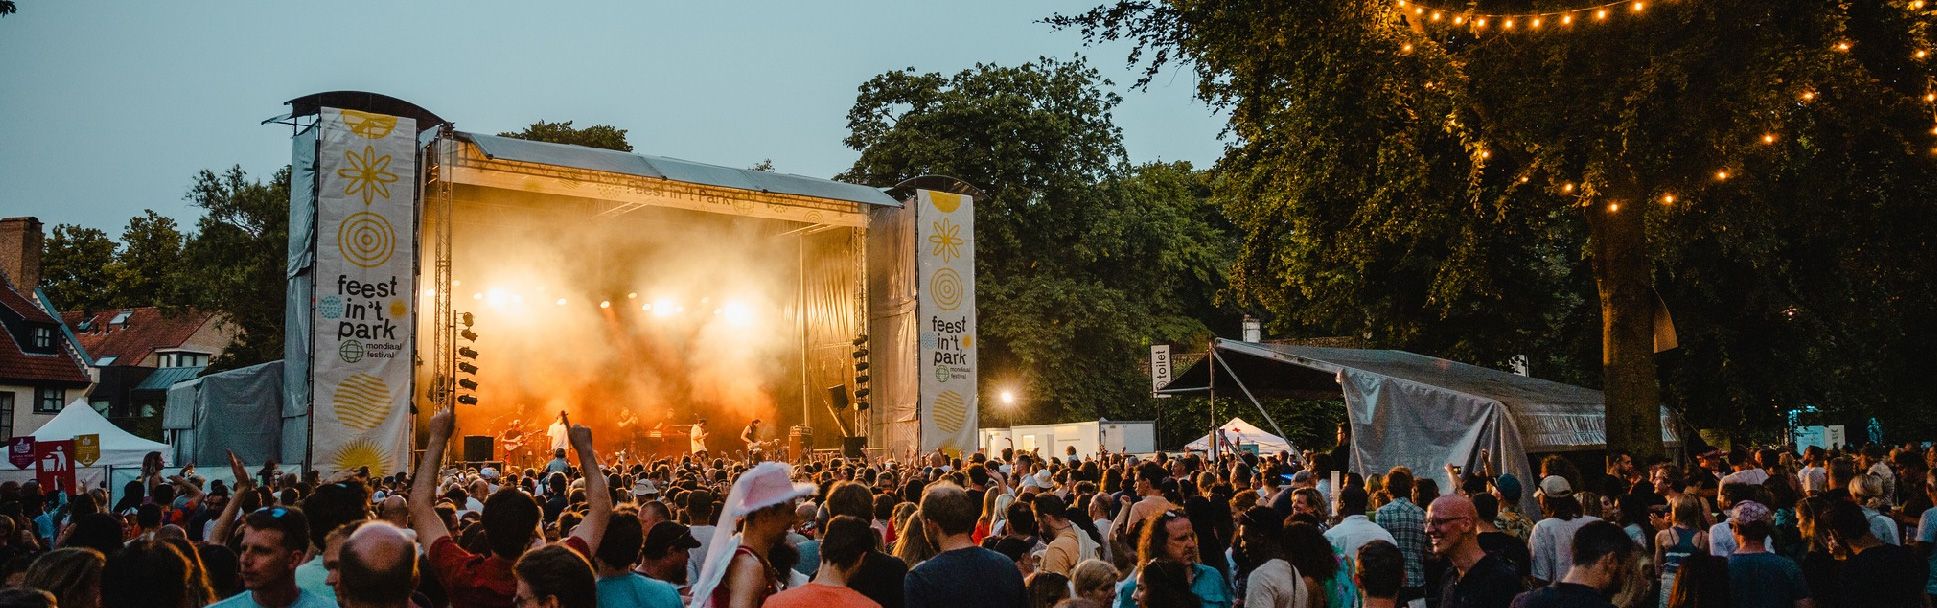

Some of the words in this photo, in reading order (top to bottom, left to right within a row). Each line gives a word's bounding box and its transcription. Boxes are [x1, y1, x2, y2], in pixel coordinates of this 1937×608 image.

[698, 188, 730, 205] Park
[338, 275, 397, 298] feest
[345, 298, 383, 321] in't
[338, 319, 397, 341] park
[932, 315, 966, 333] feest
[937, 333, 959, 351] in't
[934, 350, 966, 366] park
[1155, 350, 1167, 379] toilet
